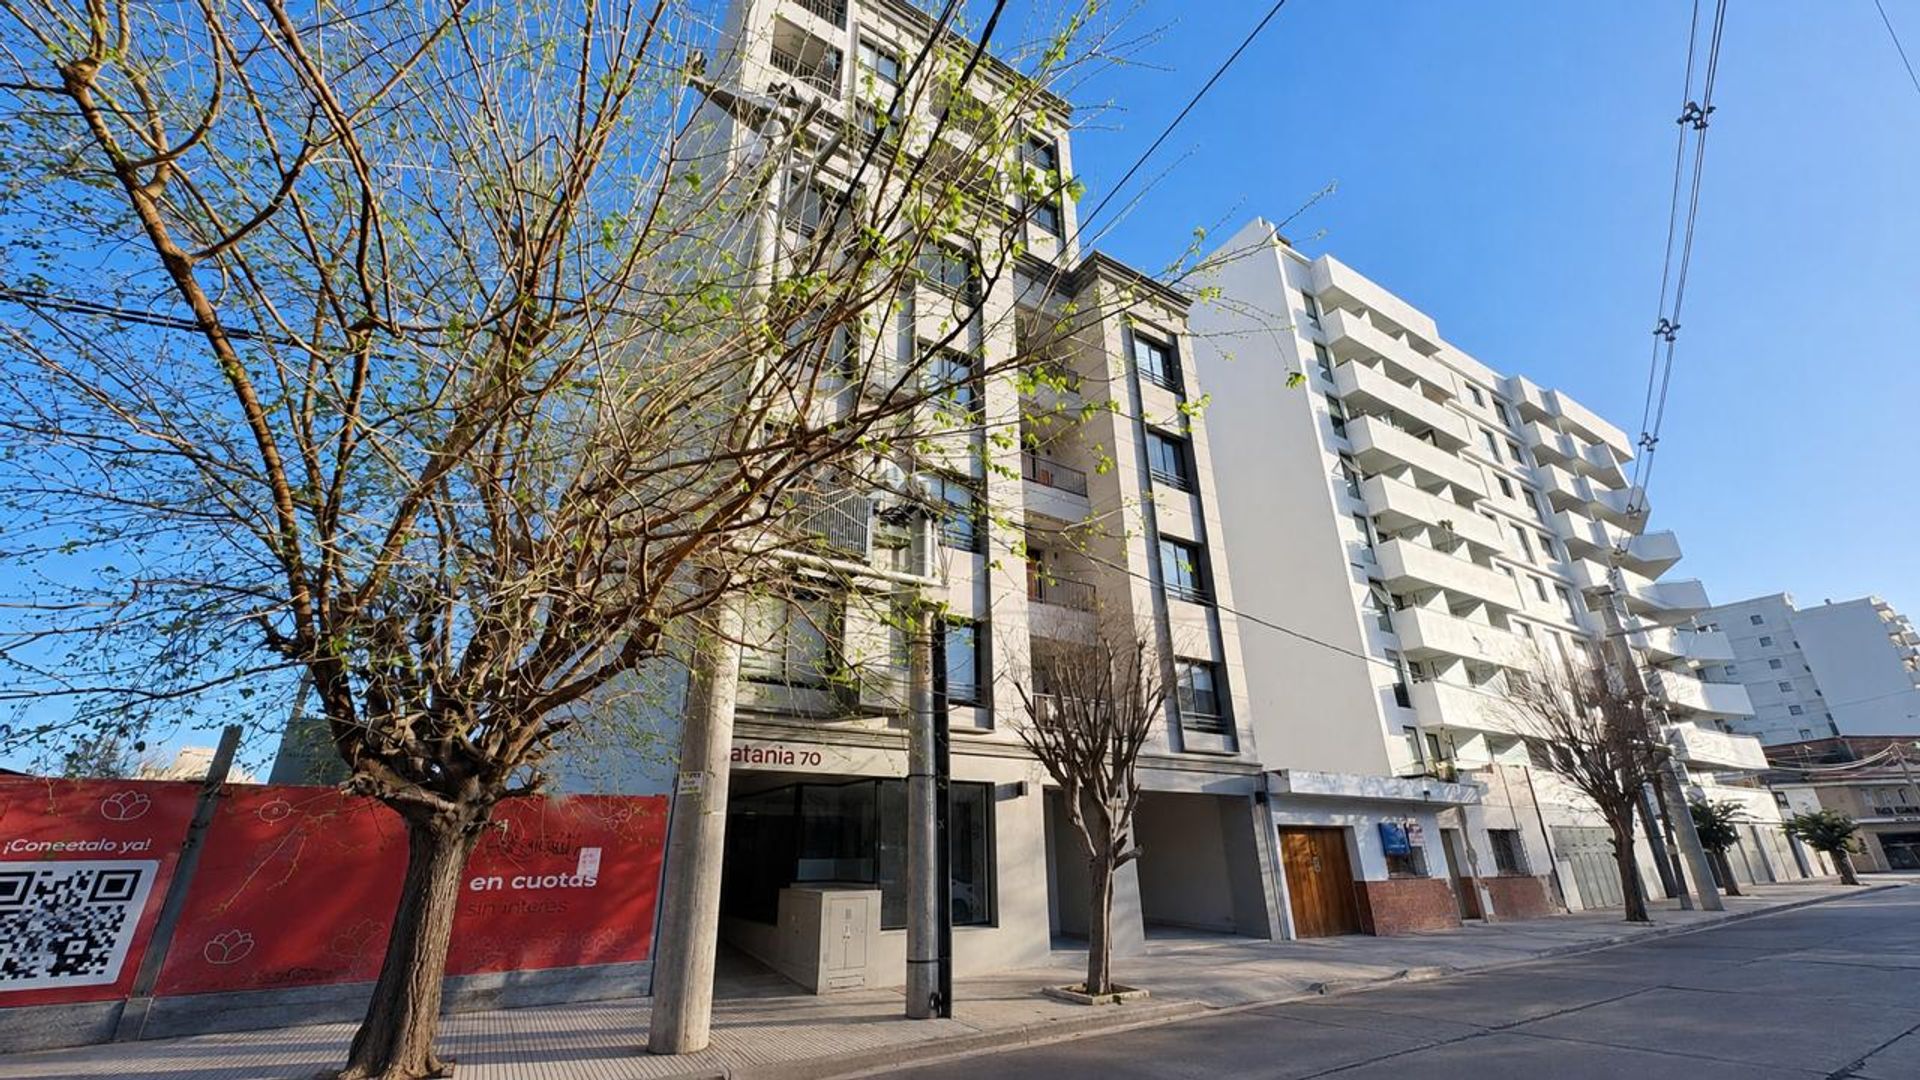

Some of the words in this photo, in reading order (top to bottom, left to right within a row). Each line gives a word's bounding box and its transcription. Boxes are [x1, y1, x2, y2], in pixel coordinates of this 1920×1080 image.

[731, 745, 795, 766] atania
[800, 751, 822, 766] 70
[119, 838, 152, 854] ya!
[470, 876, 503, 891] en
[511, 873, 598, 889] cuotas
